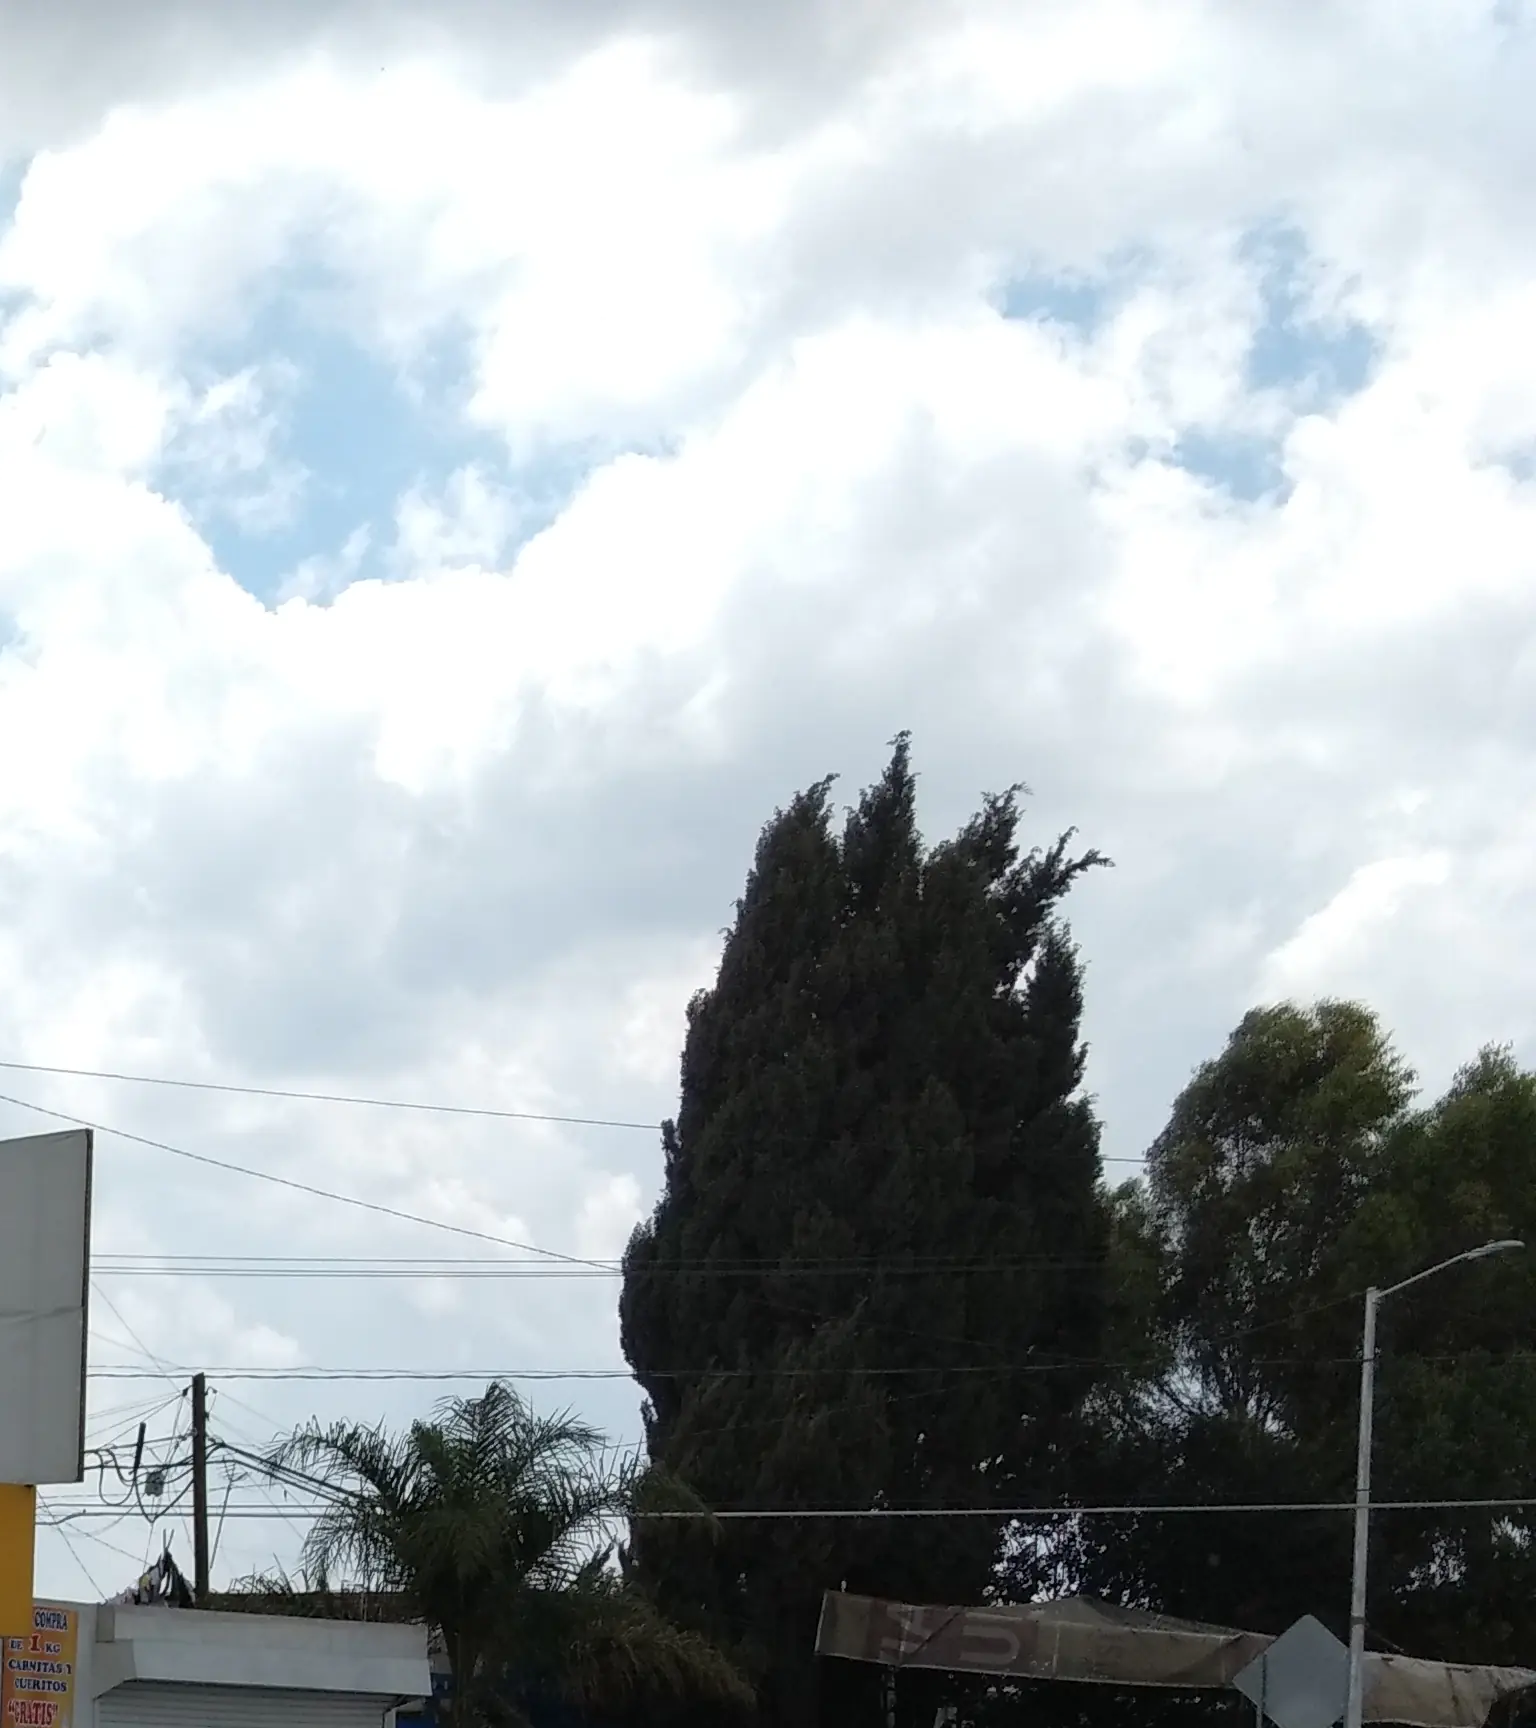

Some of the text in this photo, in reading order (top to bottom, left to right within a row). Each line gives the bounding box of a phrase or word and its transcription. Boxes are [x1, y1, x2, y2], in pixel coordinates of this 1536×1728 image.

[34, 1610, 69, 1631] COMPRA
[29, 1633, 42, 1653] 1
[44, 1642, 62, 1654] KG
[7, 1659, 63, 1675] CARNITAS
[14, 1676, 68, 1693] CUERITOS
